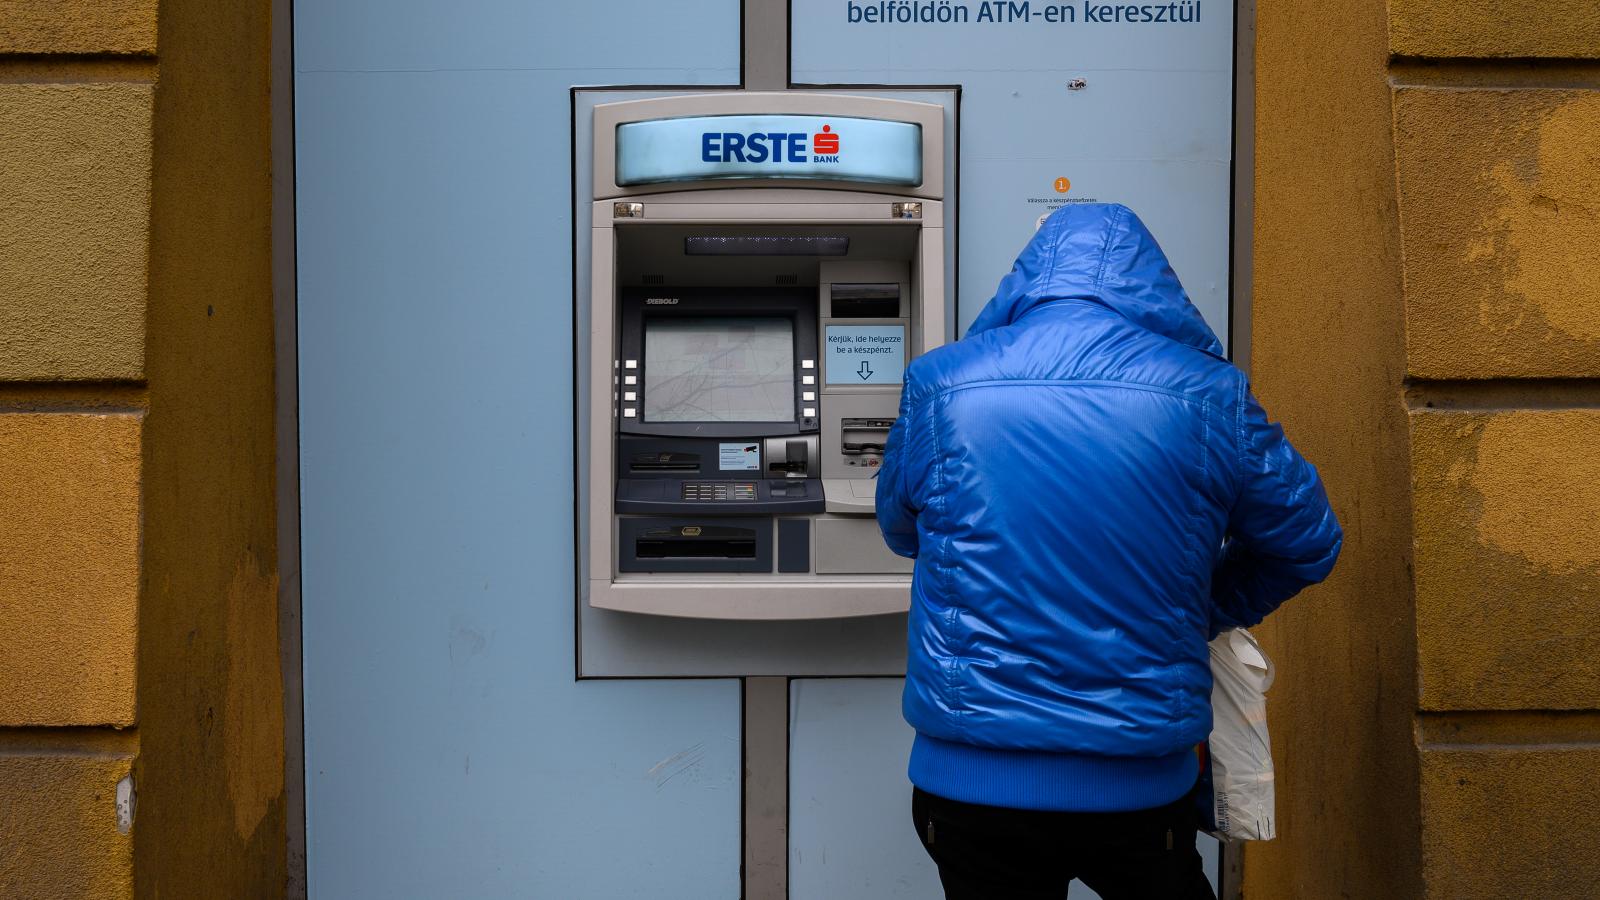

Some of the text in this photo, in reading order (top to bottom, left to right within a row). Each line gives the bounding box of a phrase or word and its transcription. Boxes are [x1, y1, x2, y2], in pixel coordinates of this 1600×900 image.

[847, 0, 1202, 23] belföldön ATM-en keresztül
[702, 132, 808, 163] ERSTE
[813, 155, 840, 163] BANK
[828, 335, 854, 344] Kérjük,
[868, 335, 902, 344] helyezze
[836, 346, 846, 354] be
[854, 346, 894, 355] készpénzt.
